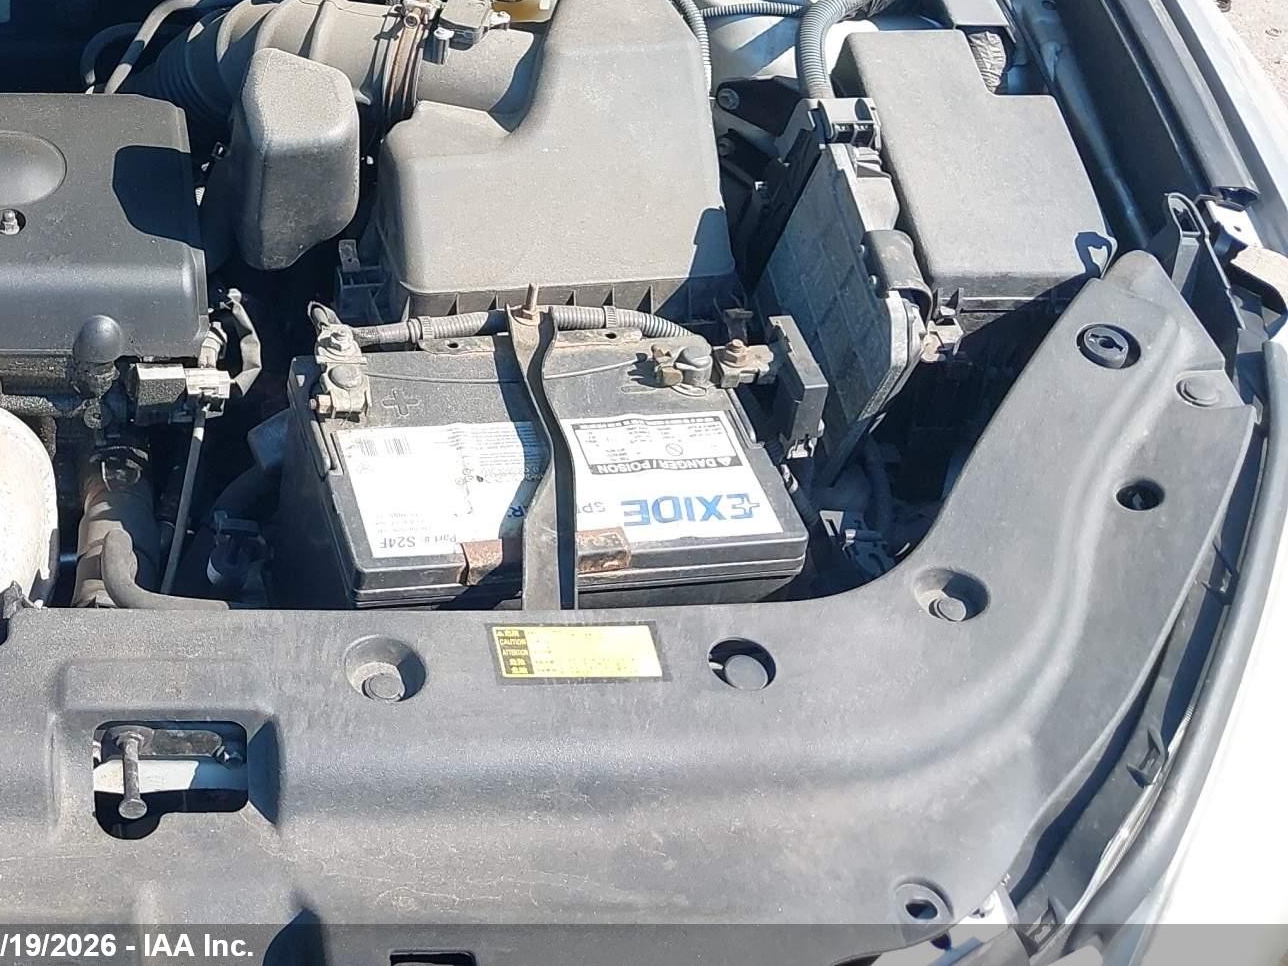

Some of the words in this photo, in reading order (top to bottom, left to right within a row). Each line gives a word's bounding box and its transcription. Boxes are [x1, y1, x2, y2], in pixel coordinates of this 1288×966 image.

[597, 458, 652, 475] POISON
[659, 456, 714, 471] DANGER
[621, 493, 760, 527] EXIDE
[379, 536, 416, 549] S24F
[435, 534, 457, 544] Part
[499, 638, 527, 646] CAUTION
